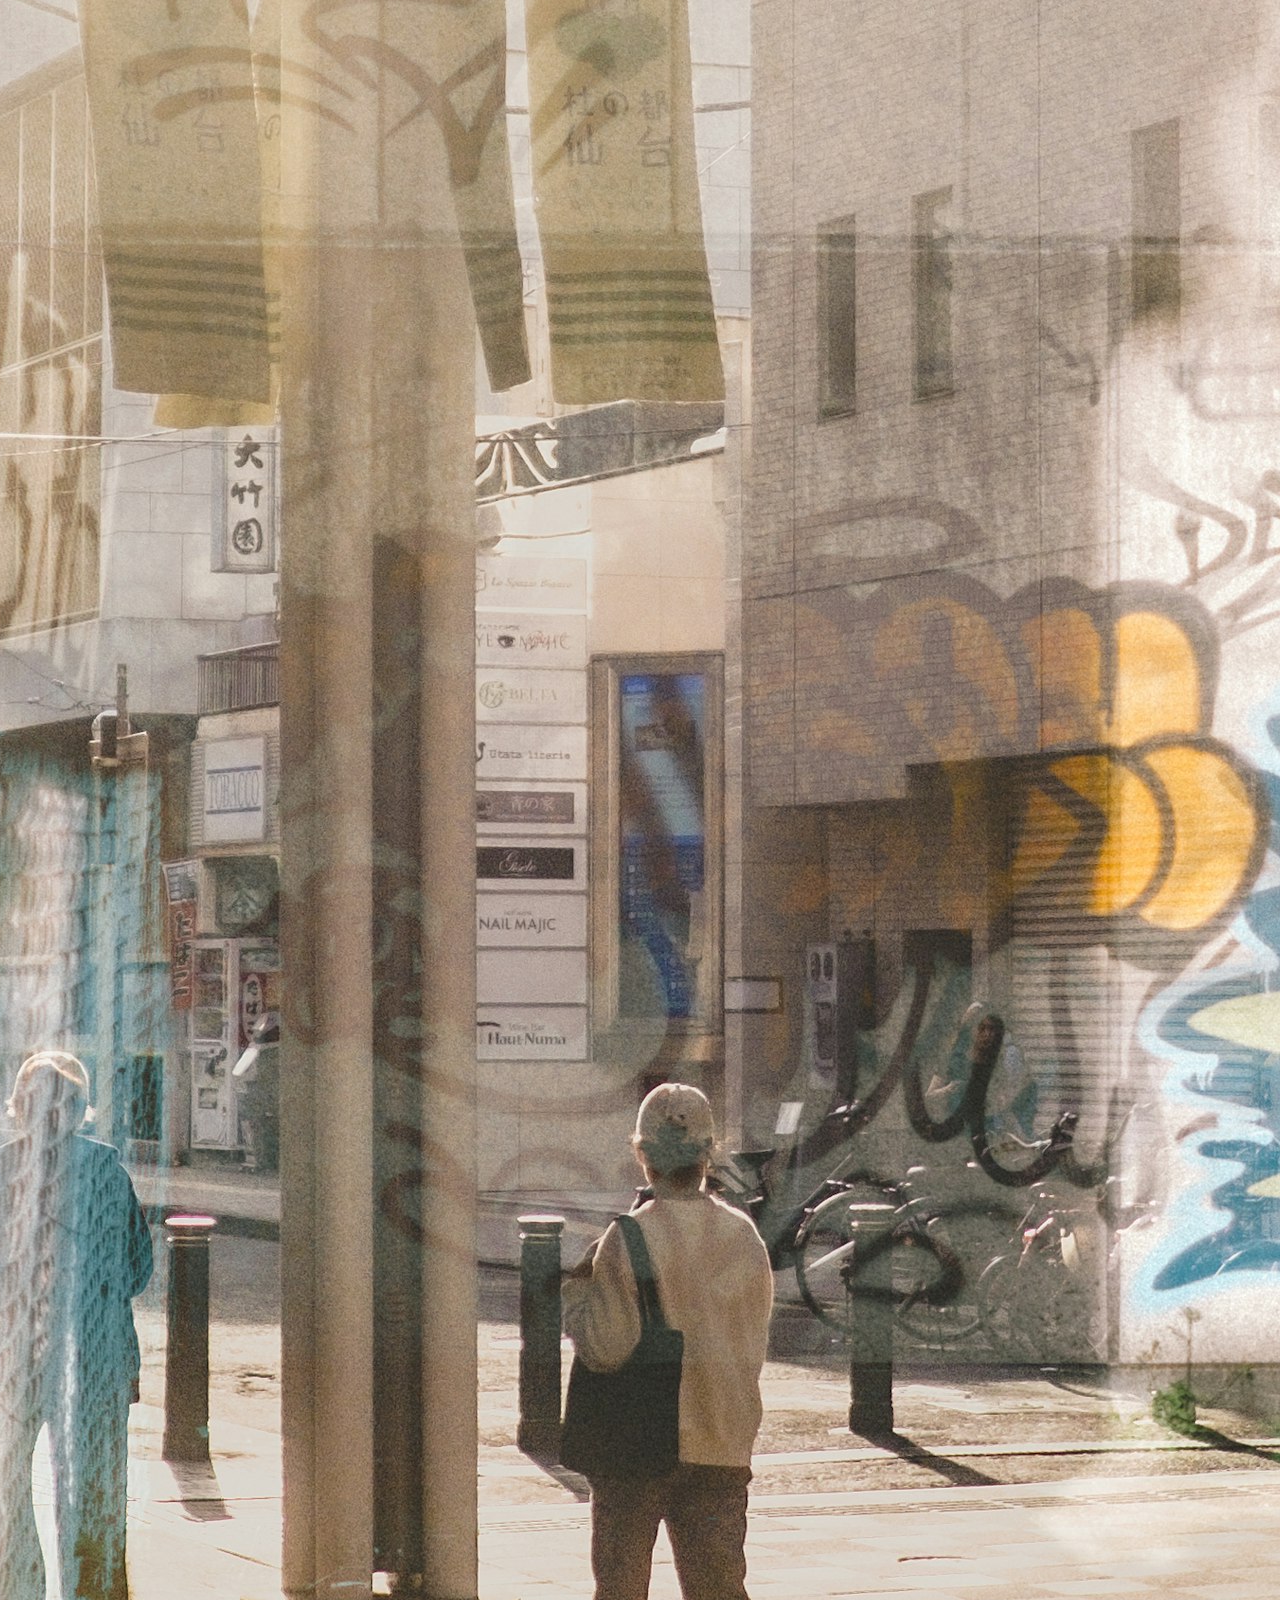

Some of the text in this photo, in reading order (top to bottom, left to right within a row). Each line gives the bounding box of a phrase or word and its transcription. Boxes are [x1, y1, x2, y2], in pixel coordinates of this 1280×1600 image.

[563, 123, 673, 168] 仙台
[230, 433, 264, 555] 大竹園
[208, 771, 260, 809] TOBACCO
[479, 917, 557, 934] NAIL MAJIC
